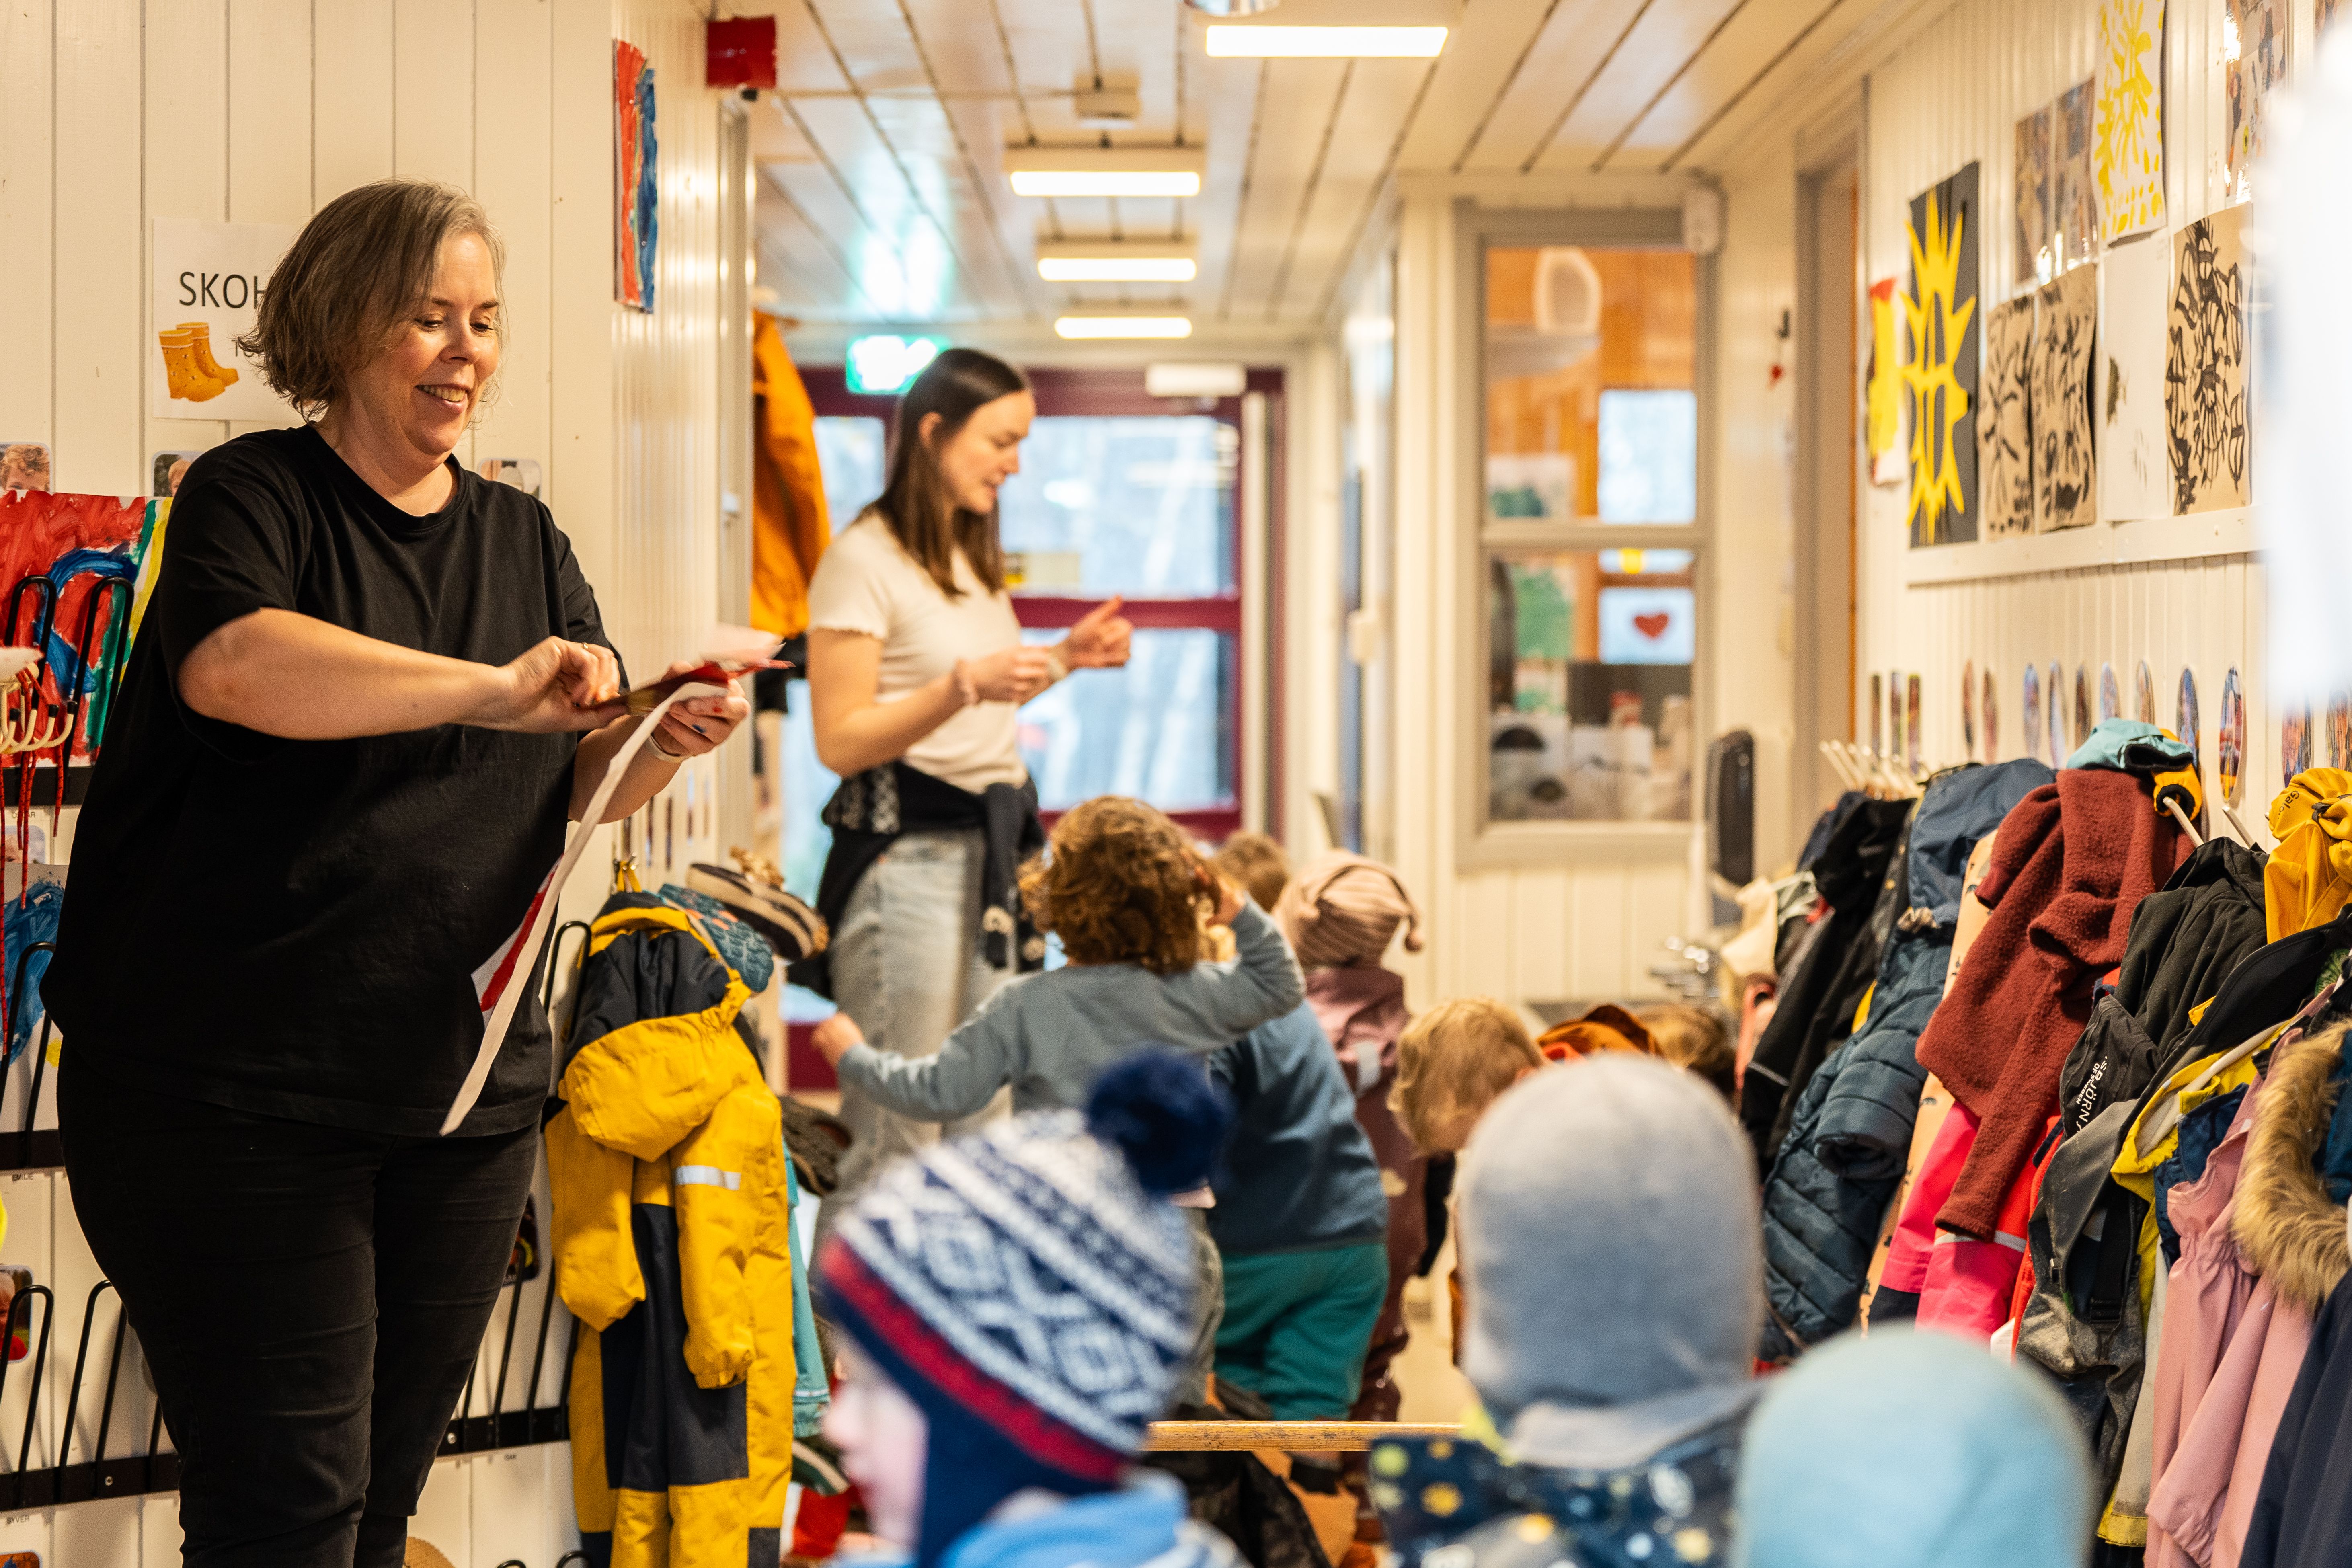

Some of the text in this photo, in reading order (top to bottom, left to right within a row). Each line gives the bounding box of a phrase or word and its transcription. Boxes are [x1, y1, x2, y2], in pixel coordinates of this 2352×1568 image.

[2278, 790, 2299, 819] Galo
[2092, 1063, 2100, 1074] OF
[2079, 1056, 2108, 1122] SBJÖRN
